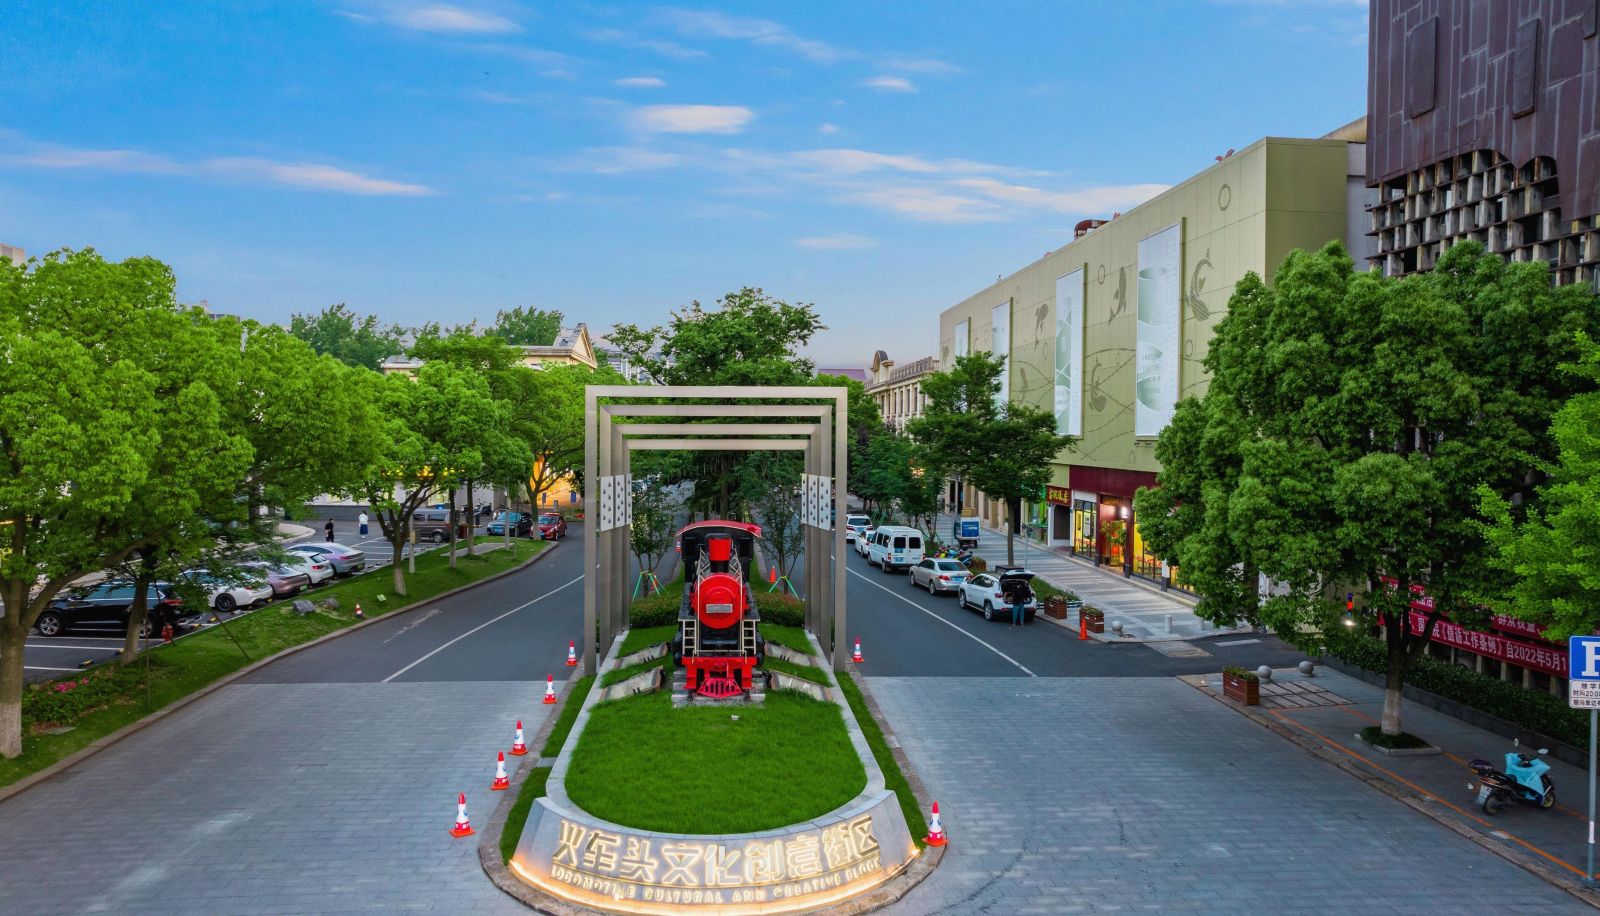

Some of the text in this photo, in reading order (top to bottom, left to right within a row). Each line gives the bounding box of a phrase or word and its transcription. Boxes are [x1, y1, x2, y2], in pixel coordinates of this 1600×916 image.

[551, 857, 881, 904] LOCOMOTIVE CULTURAL AND CREATIVE BLOCK
[552, 814, 880, 887] 火车头文化创意街区
